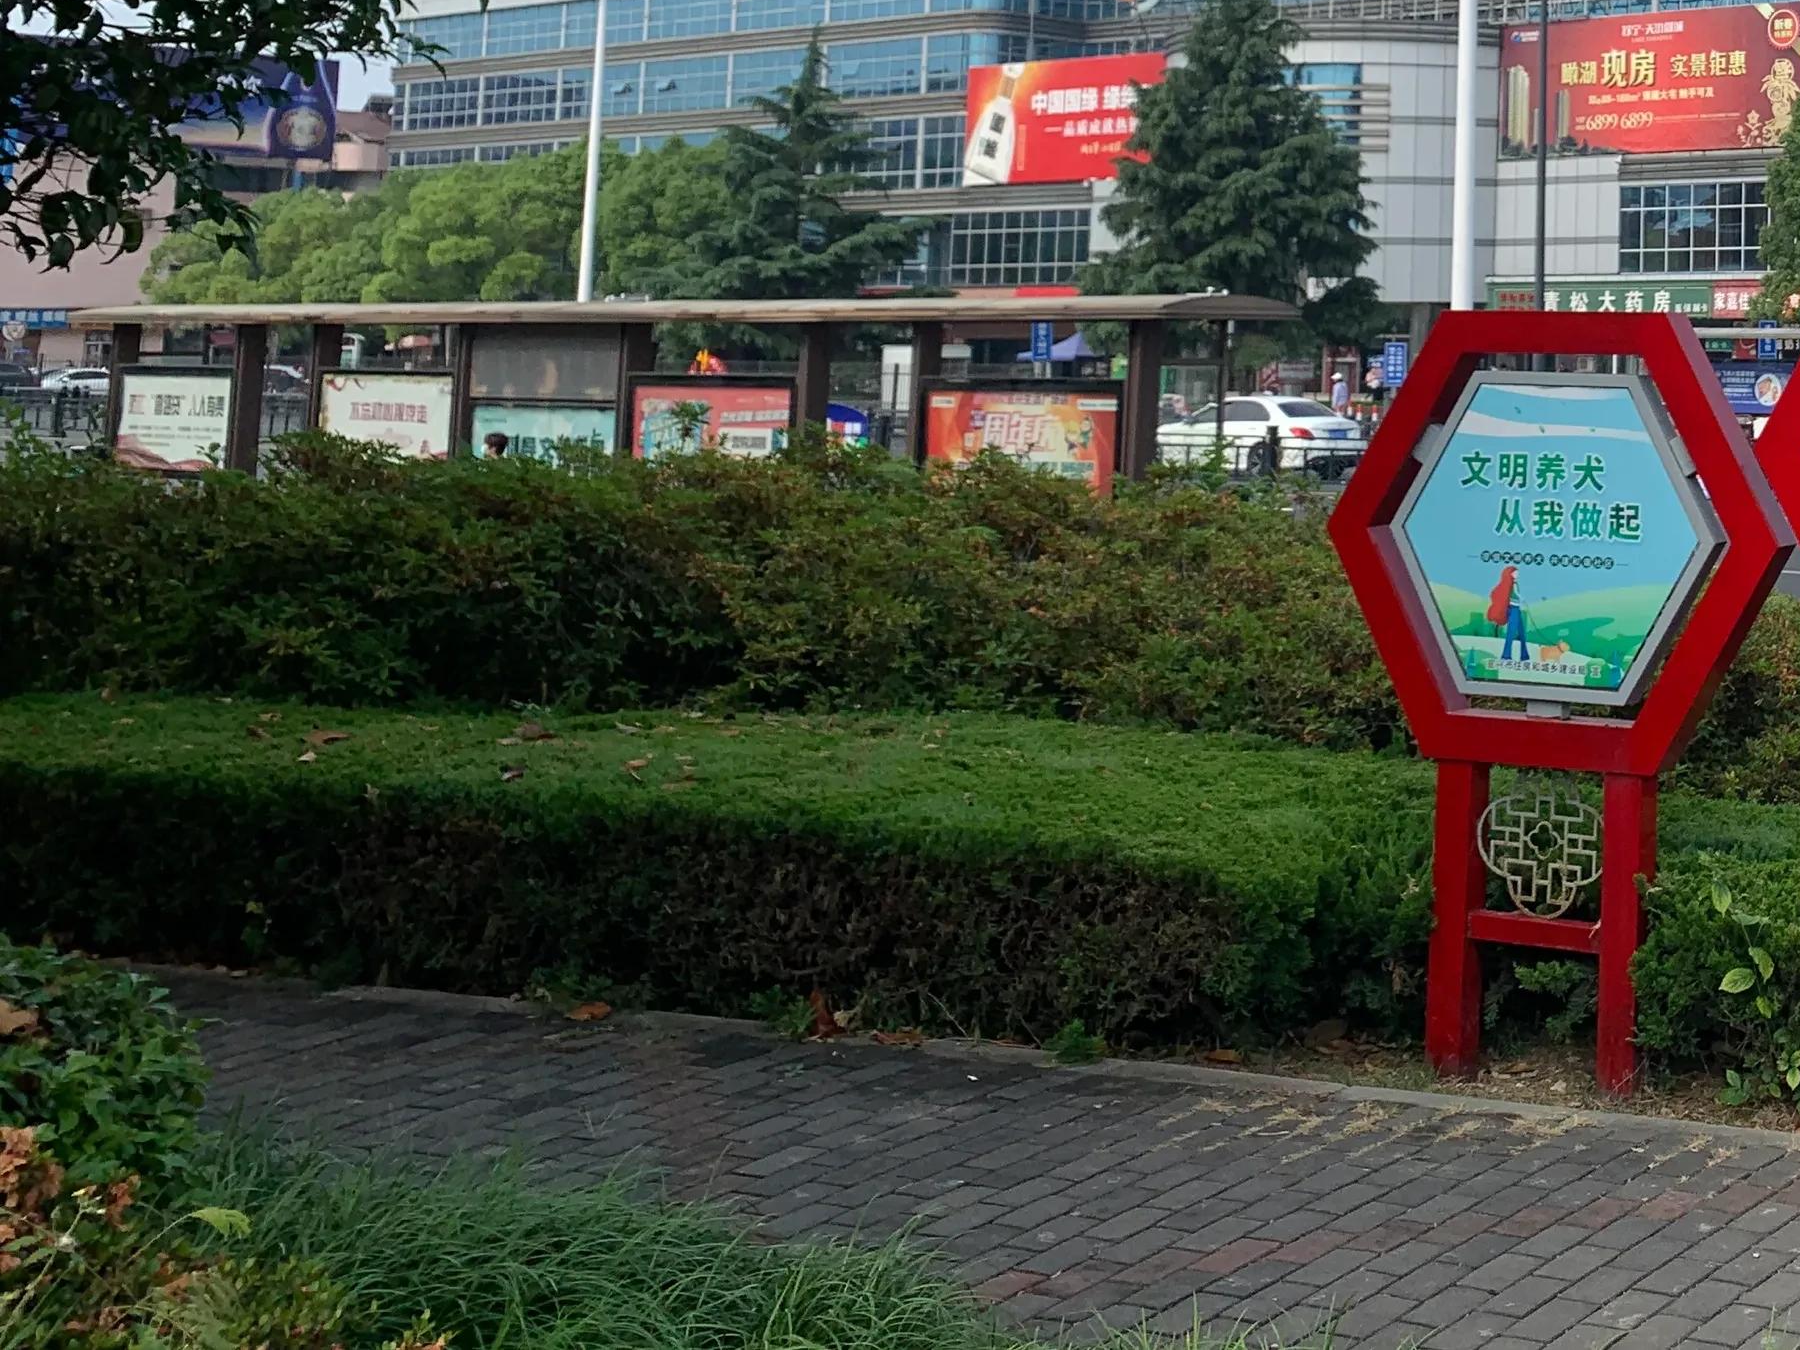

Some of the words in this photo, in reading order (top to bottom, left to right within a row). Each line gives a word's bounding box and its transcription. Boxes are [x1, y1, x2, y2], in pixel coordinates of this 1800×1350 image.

[1670, 50, 1747, 78] 实景钜惠
[1031, 87, 1098, 116] 中国国缘
[1544, 290, 1672, 312] 青松大药房
[1460, 451, 1605, 492] 文明养犬
[1495, 498, 1641, 541] 从我做起
